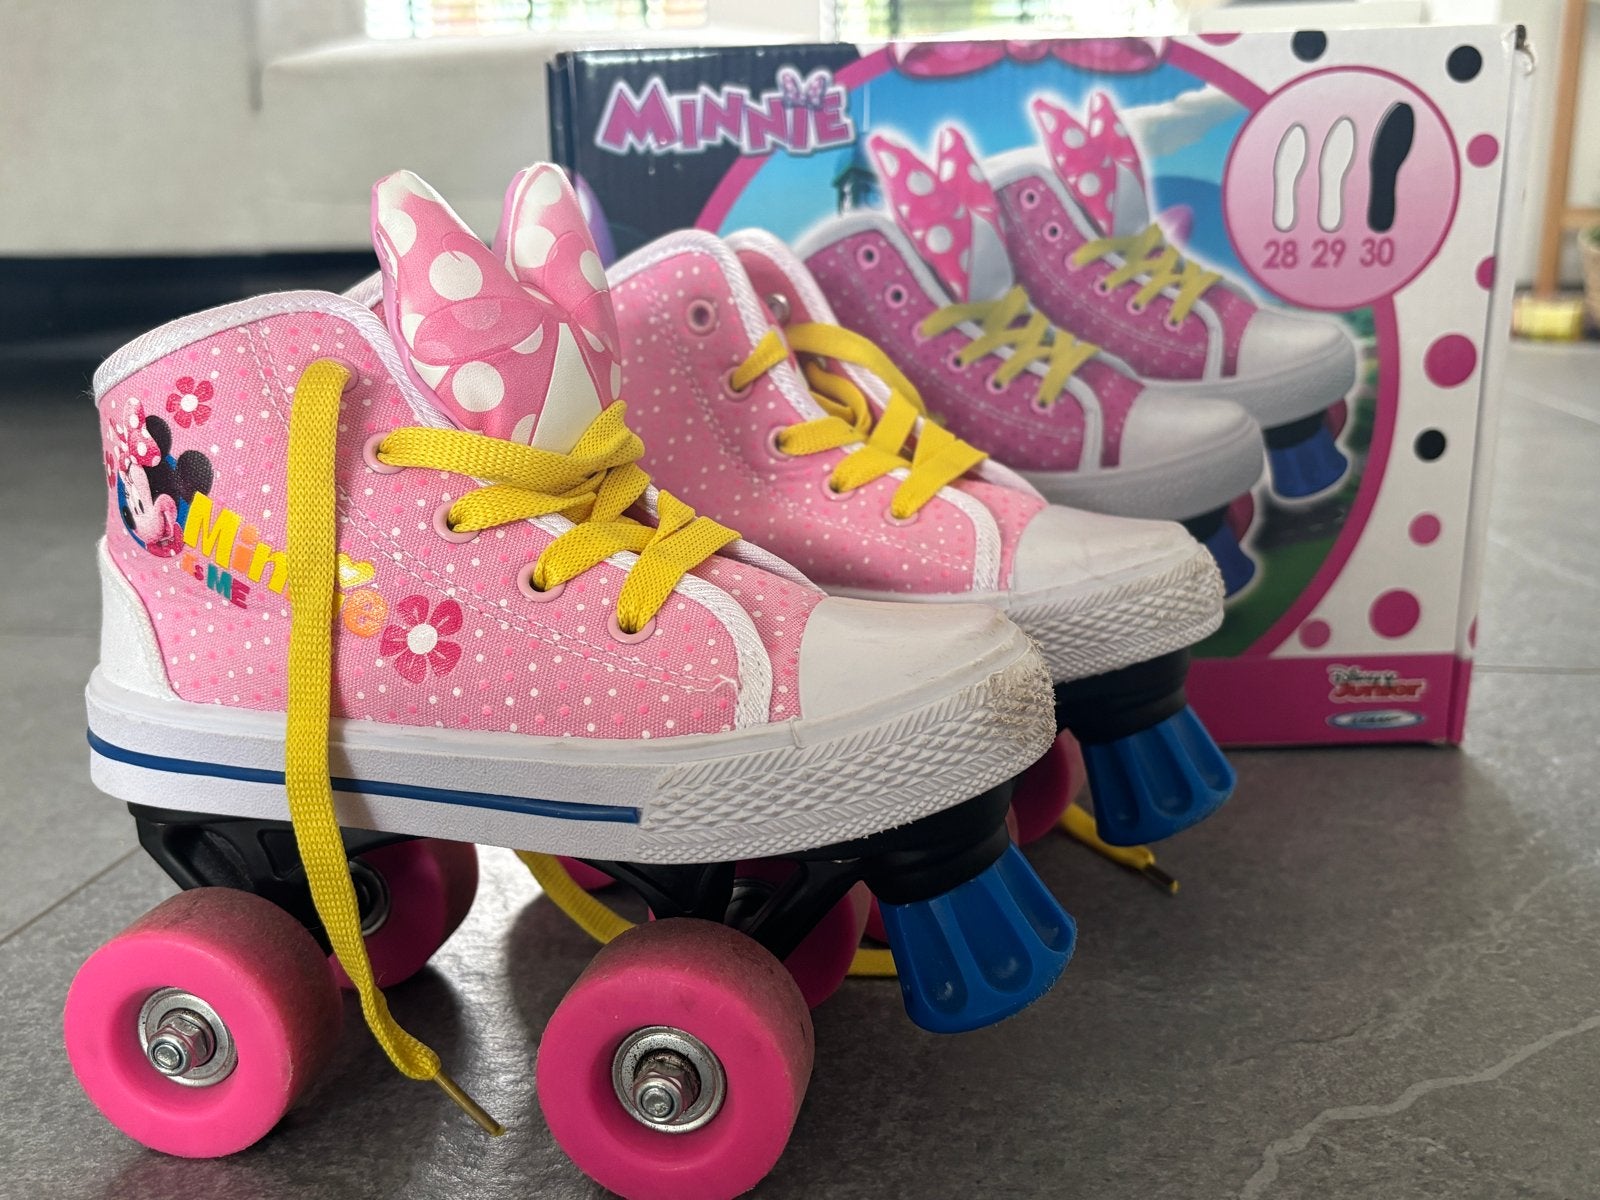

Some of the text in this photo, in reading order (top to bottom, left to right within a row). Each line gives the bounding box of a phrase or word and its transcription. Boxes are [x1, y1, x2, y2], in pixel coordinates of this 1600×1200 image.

[596, 76, 853, 154] MINNIE
[1262, 237, 1395, 270] 28 29 30
[182, 490, 389, 638] Mine
[207, 563, 250, 609] ME
